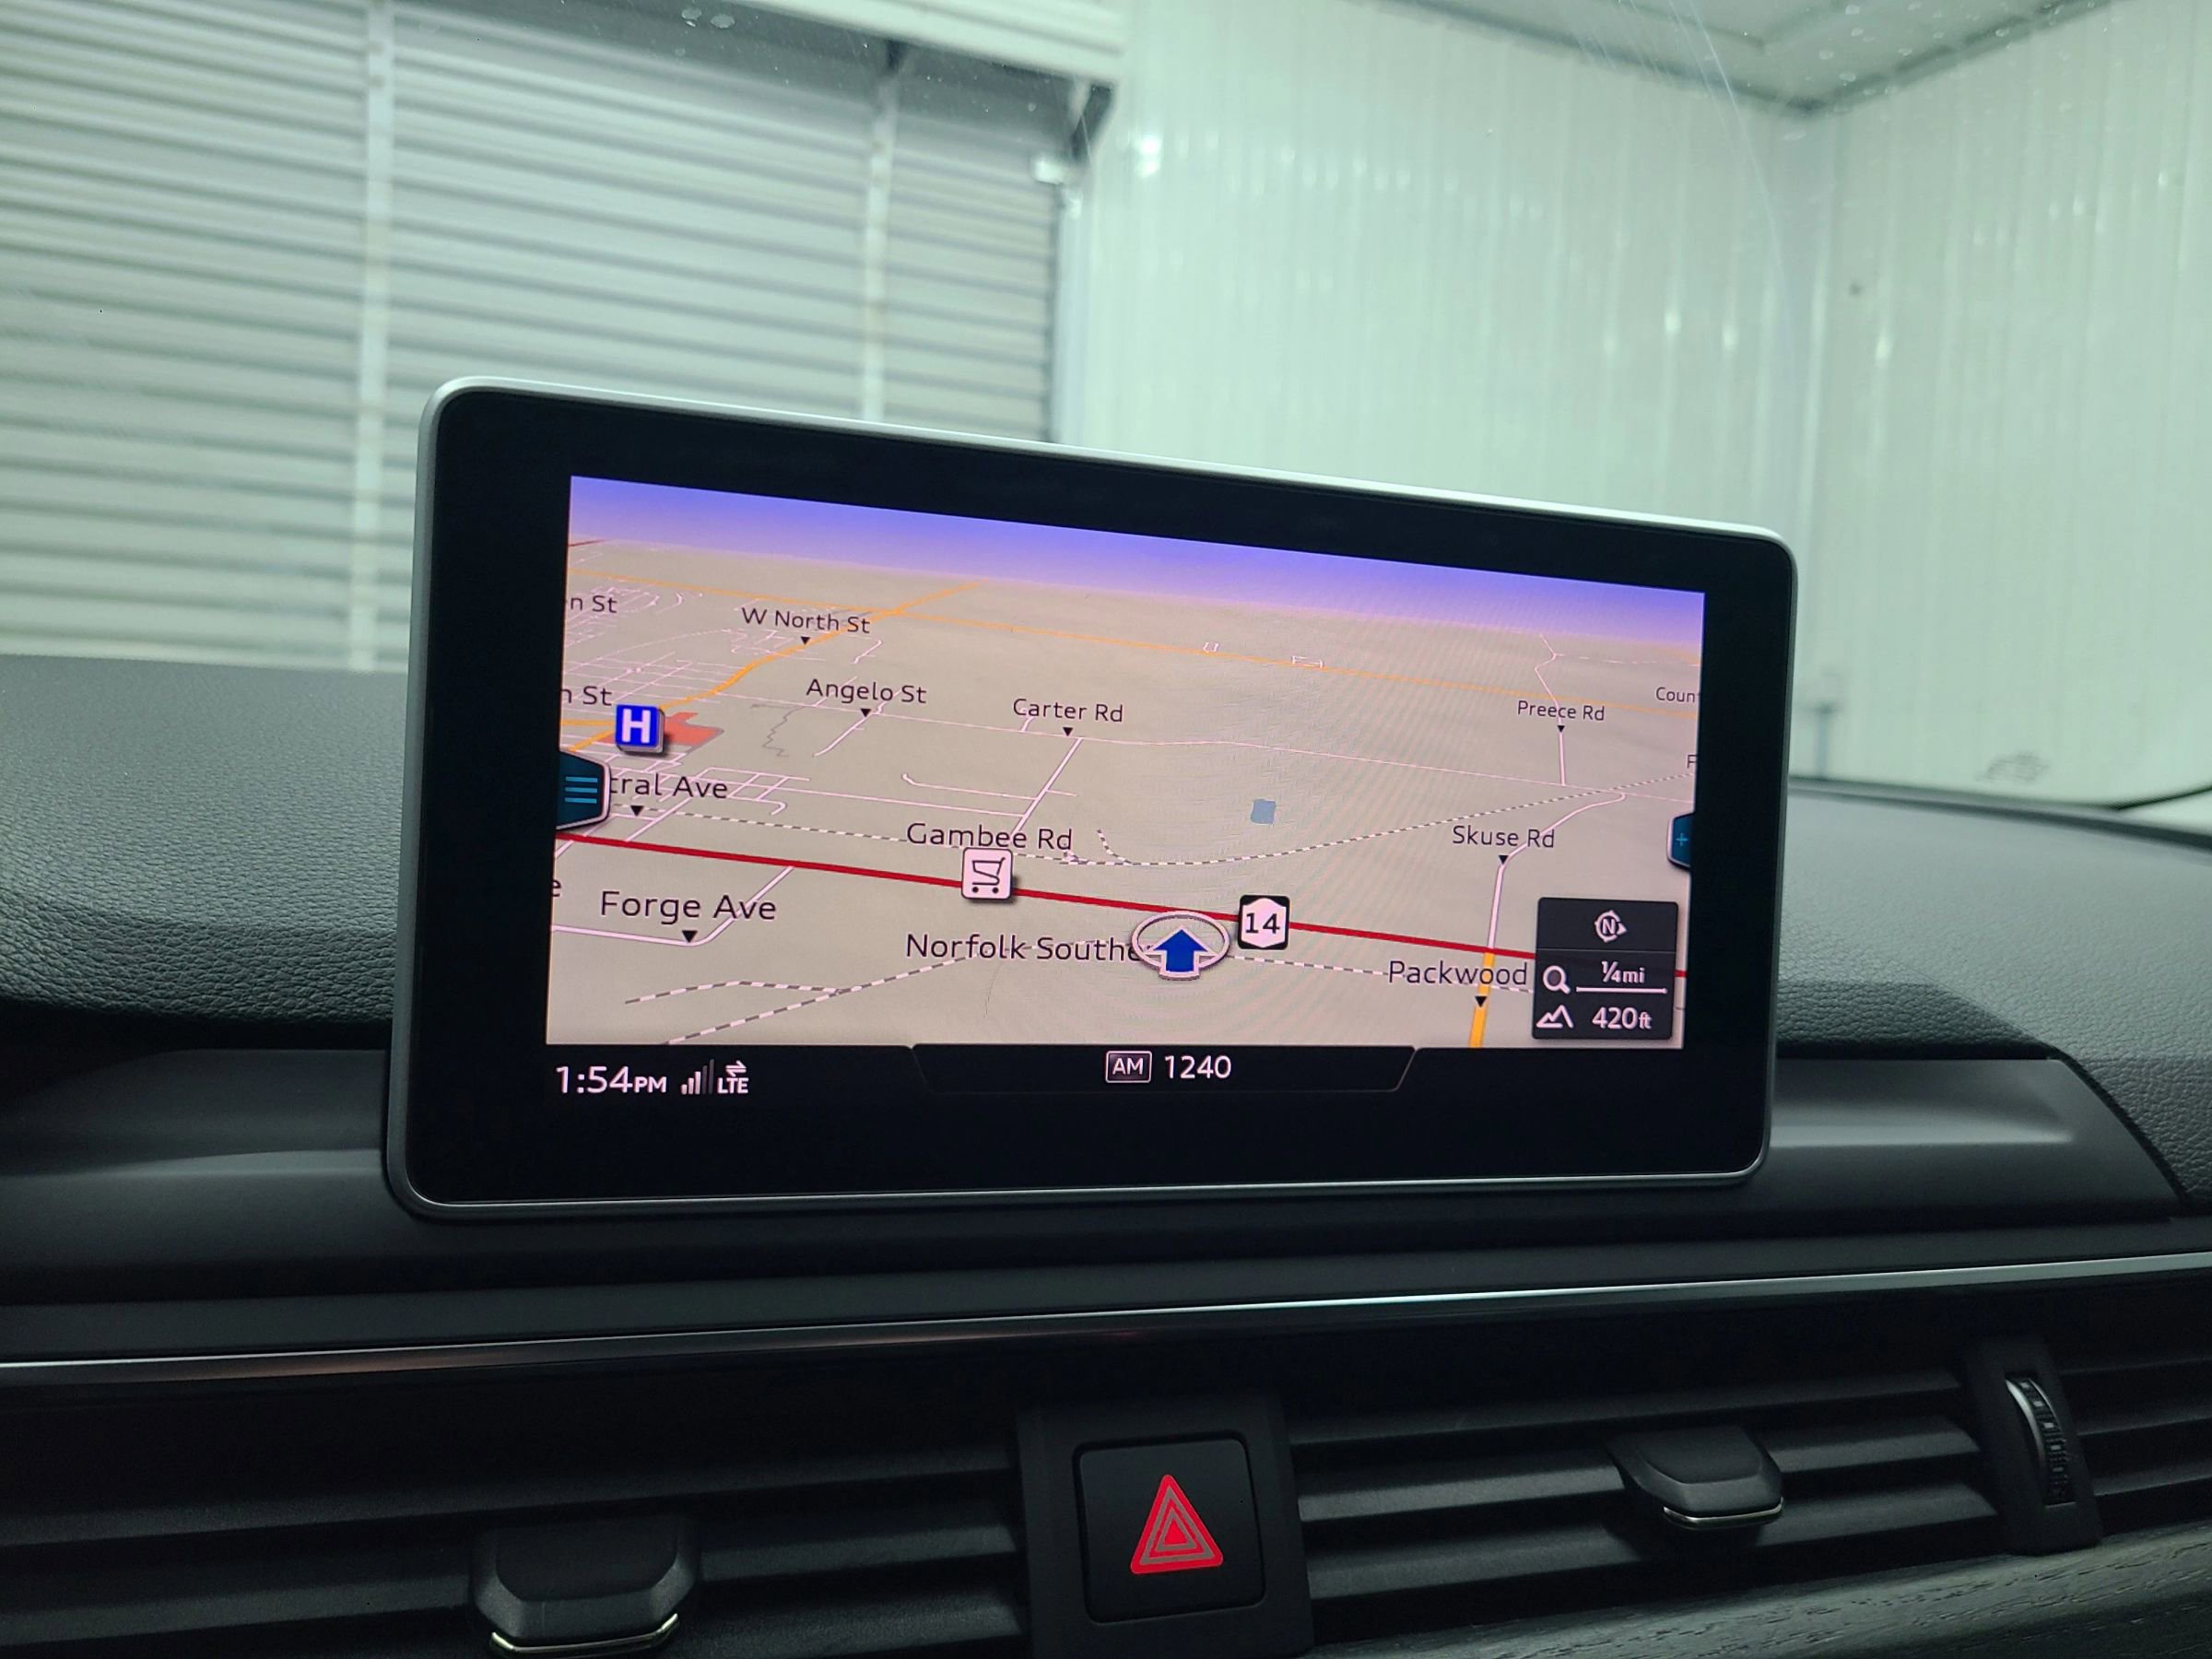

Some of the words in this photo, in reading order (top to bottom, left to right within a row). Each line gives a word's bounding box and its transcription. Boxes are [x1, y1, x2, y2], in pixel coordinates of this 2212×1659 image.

[592, 594, 618, 614] St
[741, 607, 767, 625] W
[775, 611, 840, 631] North
[847, 617, 871, 634] St
[582, 686, 612, 706] St
[806, 678, 893, 704] Angelo
[901, 685, 927, 704] St
[1656, 687, 1700, 702] Coun
[1013, 698, 1088, 721] Carter
[1095, 703, 1124, 723] Rd
[1517, 700, 1577, 719] Preece
[1583, 705, 1606, 721] Rd
[620, 708, 652, 744] H
[672, 776, 728, 799] Ave
[907, 822, 1028, 851] Gambee
[1038, 828, 1072, 850] Rd
[1452, 825, 1519, 847] Skuse
[1527, 829, 1555, 848] Rd
[601, 890, 701, 925] Forge
[712, 894, 776, 920] Ave
[1244, 912, 1281, 935] 14
[906, 933, 1027, 959] Norfolk
[1388, 959, 1528, 986] Packwood
[1112, 1057, 1144, 1077] AM
[1164, 1054, 1232, 1079] 1240
[717, 1077, 749, 1095] LTE
